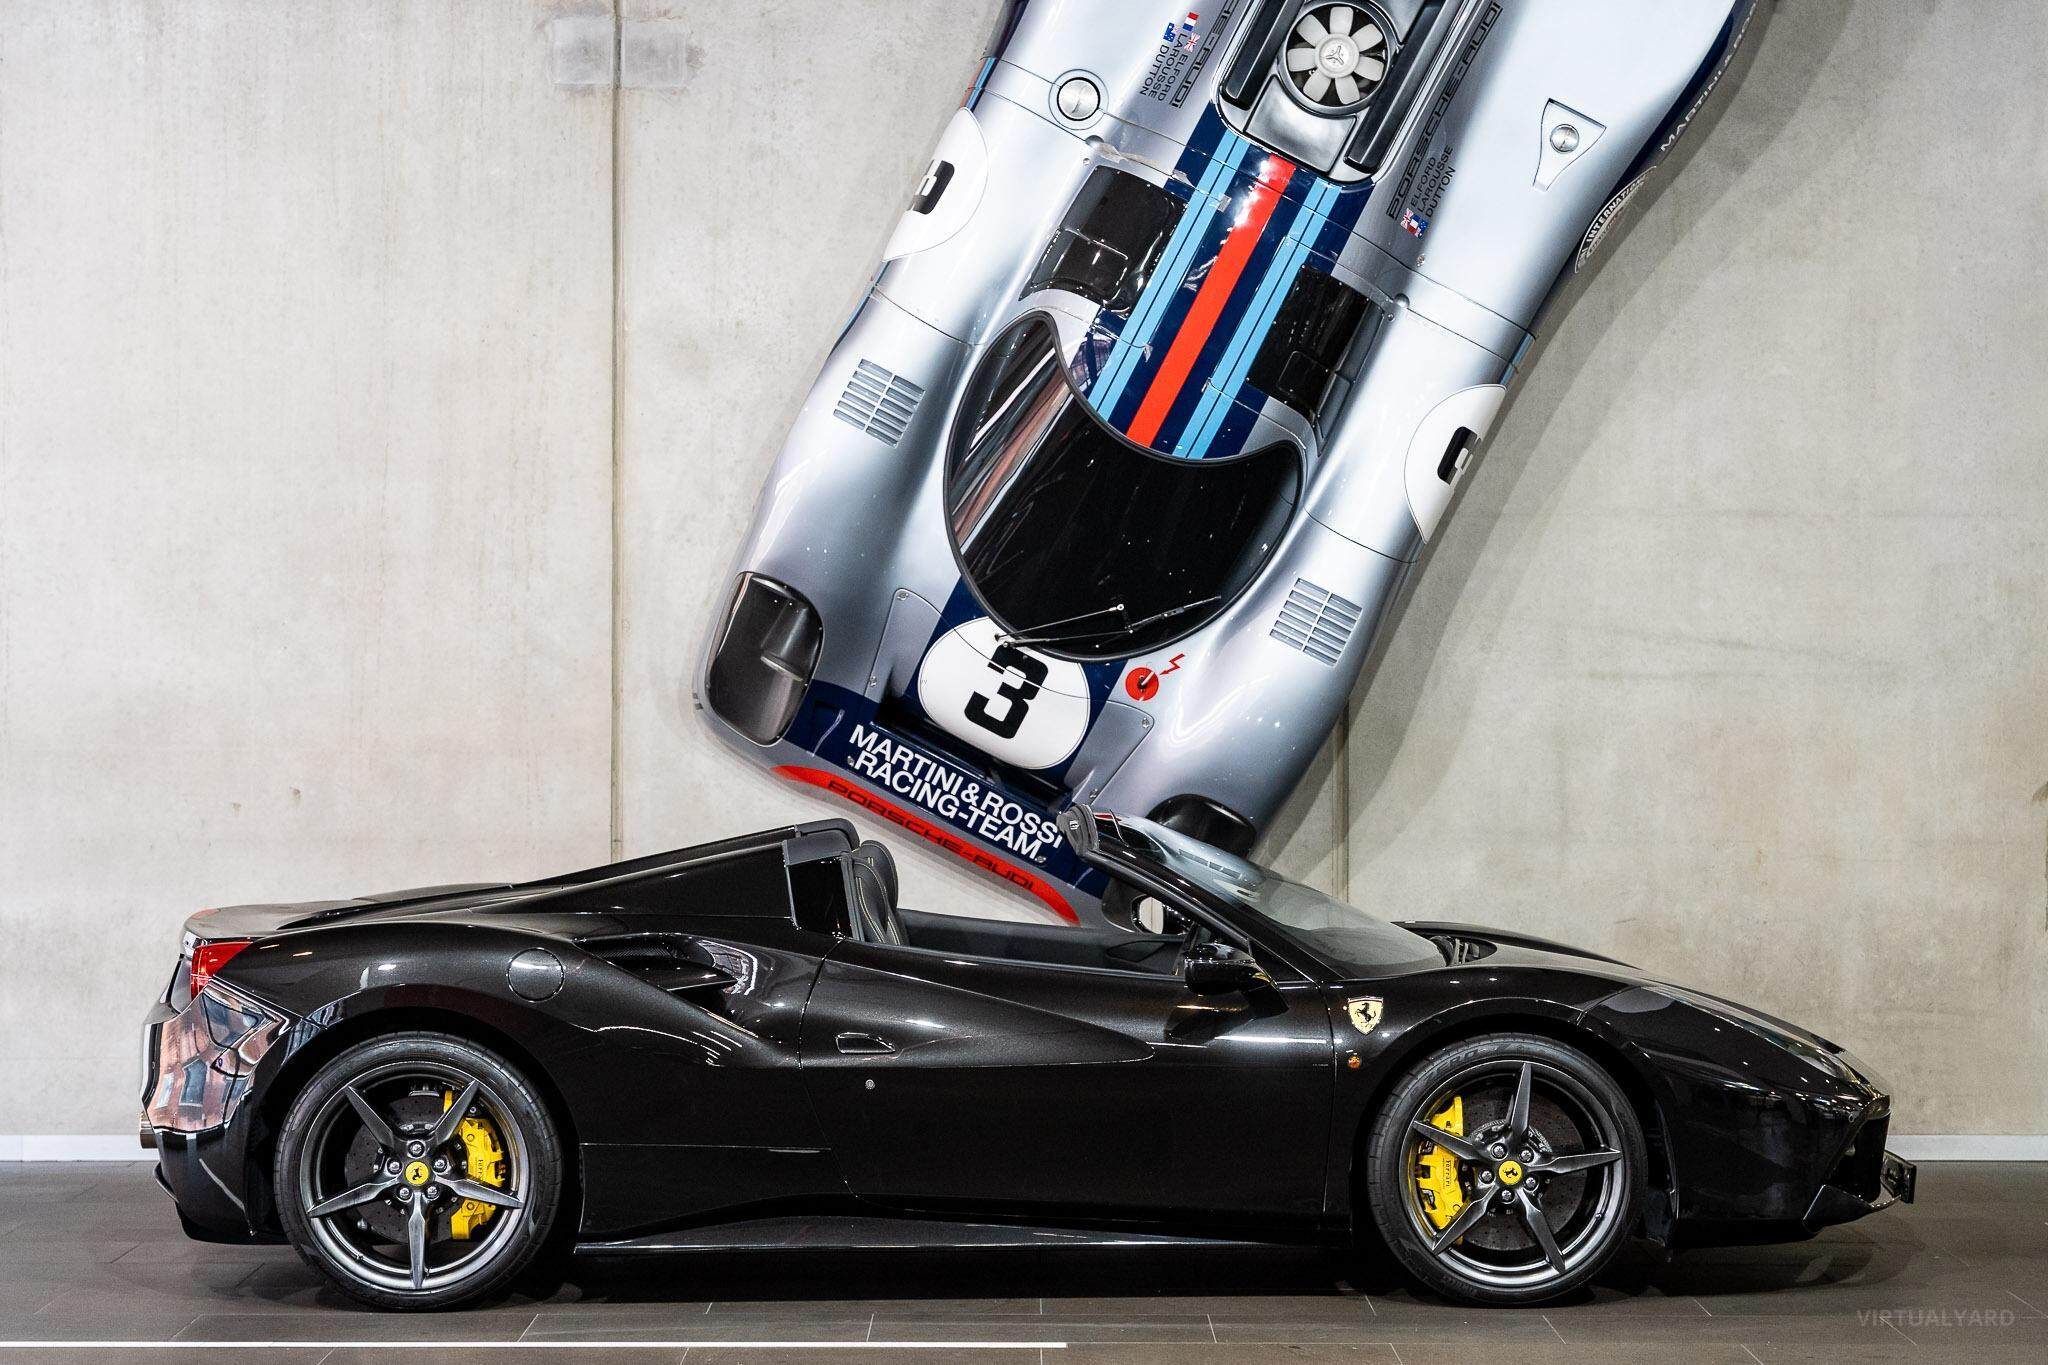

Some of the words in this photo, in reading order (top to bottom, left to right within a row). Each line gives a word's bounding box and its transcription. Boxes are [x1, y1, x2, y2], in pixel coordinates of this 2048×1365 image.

[1140, 44, 1169, 95] DUTTON
[1148, 33, 1188, 98] LAROUSSE
[1158, 54, 1188, 101] ELFORD
[1410, 157, 1436, 207] ELFORD
[1417, 145, 1453, 212] LAROUSSE
[1425, 166, 1456, 218] DUTTON
[964, 643, 1048, 739] 3
[849, 724, 964, 796] MARTINI
[960, 782, 980, 807] &
[981, 791, 1063, 849] ROSSI
[828, 780, 1034, 891] PORSCHE-AUDI
